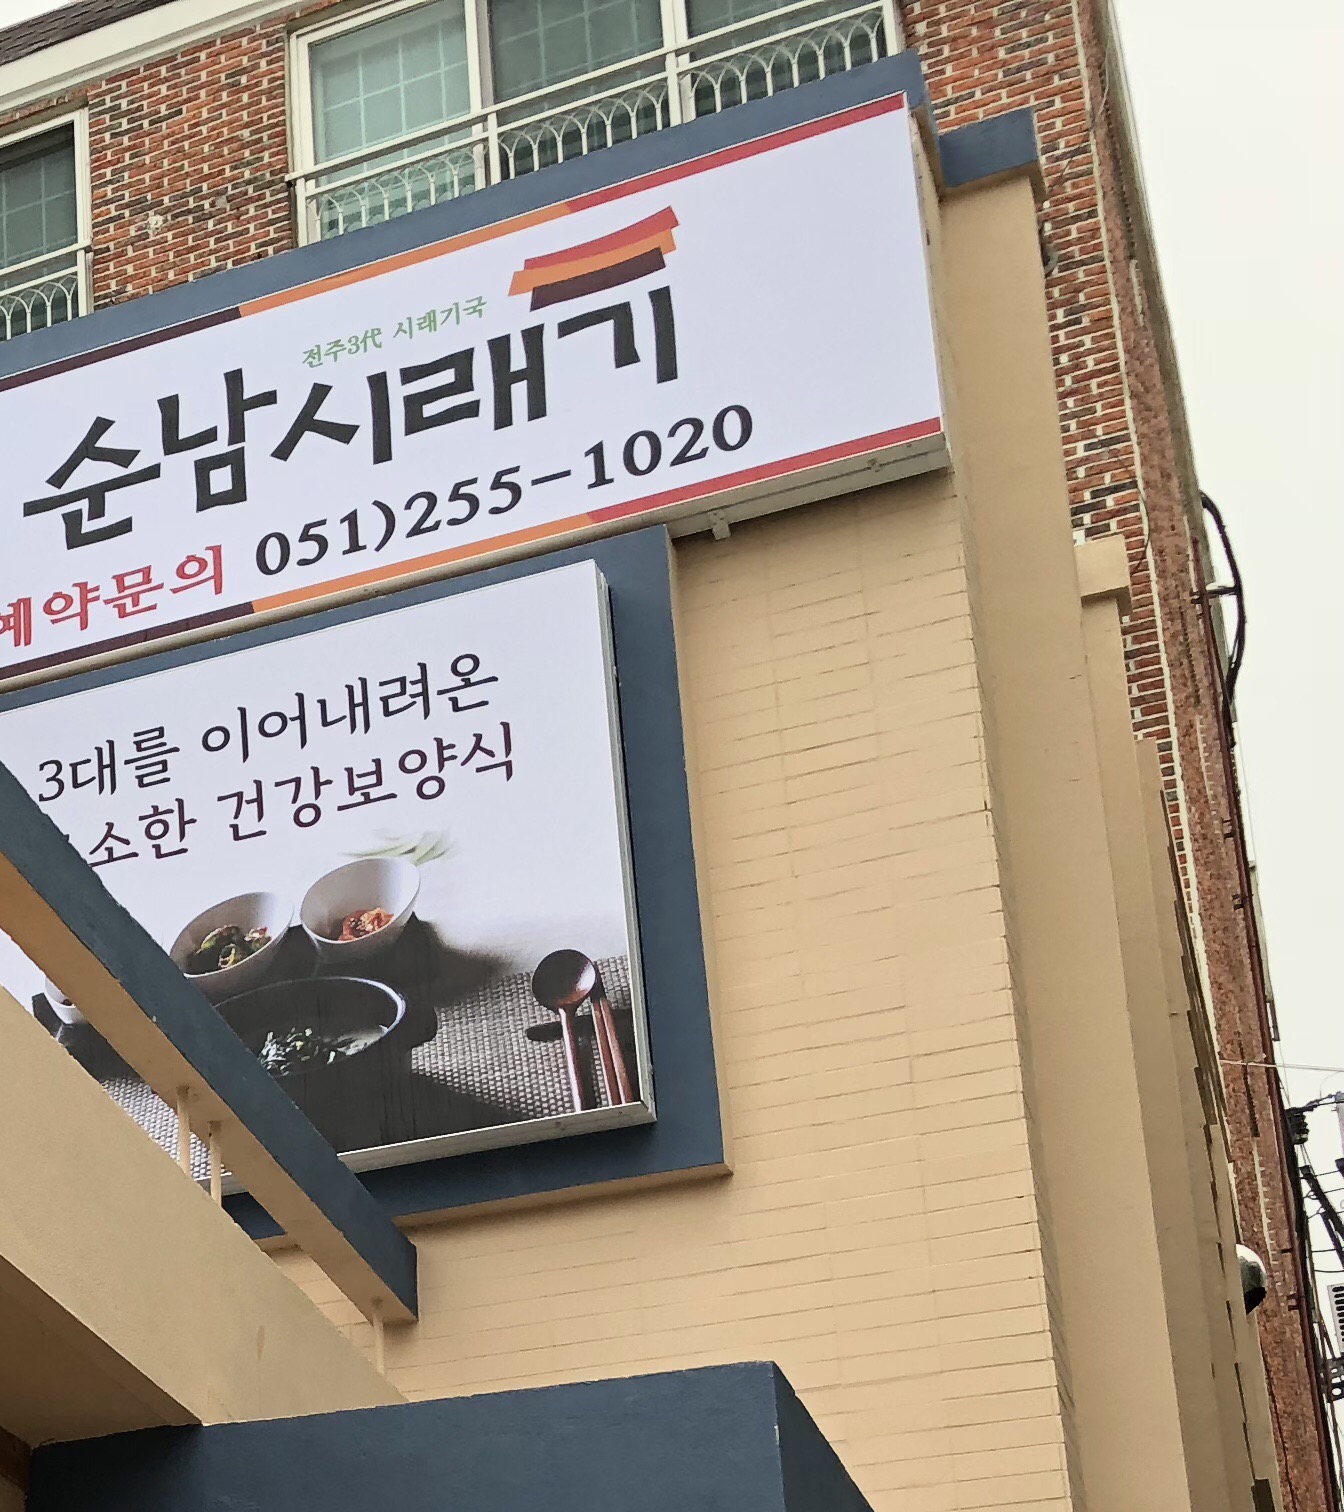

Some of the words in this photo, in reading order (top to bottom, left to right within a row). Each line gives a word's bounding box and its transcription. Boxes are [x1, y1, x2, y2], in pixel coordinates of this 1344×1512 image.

[302, 327, 382, 369] 전주3代
[393, 295, 487, 339] 시래기국
[23, 284, 679, 549] 순남시래기
[255, 403, 753, 577] 051)255-1020
[38, 725, 180, 801] 3대를
[202, 653, 498, 761] 이어내려온
[63, 799, 197, 868] 소한
[218, 721, 515, 841] 건강보양식
